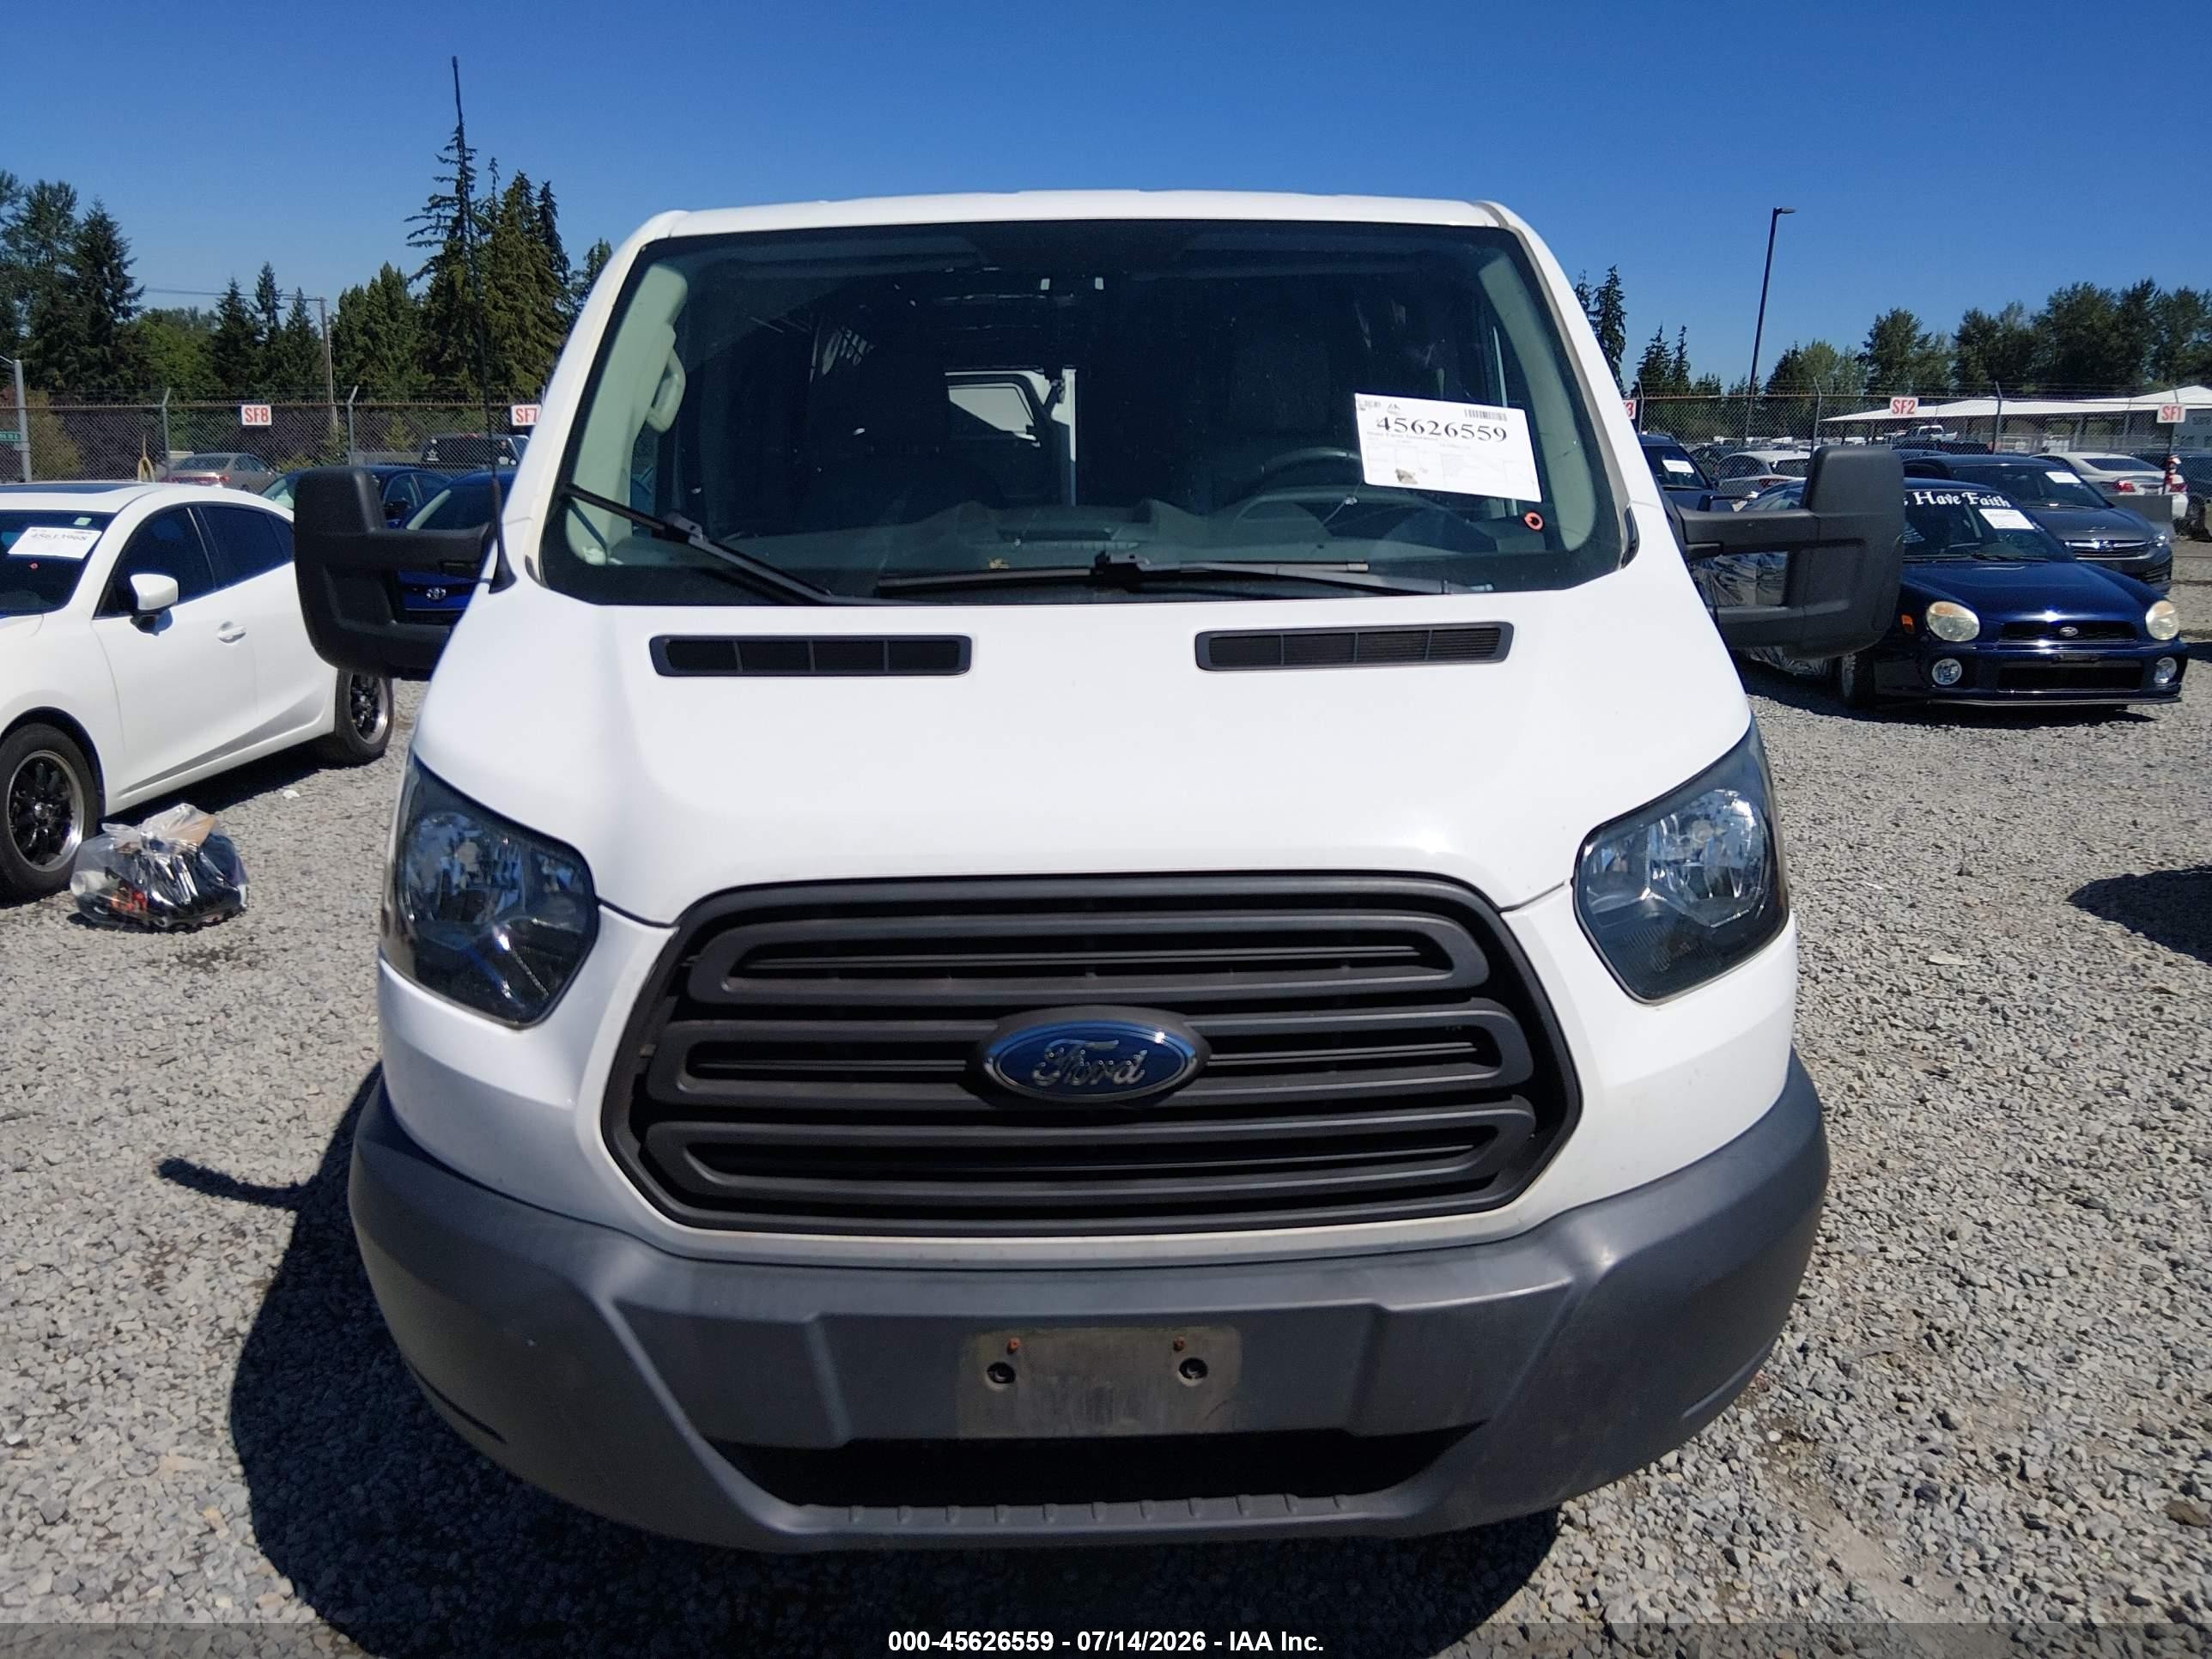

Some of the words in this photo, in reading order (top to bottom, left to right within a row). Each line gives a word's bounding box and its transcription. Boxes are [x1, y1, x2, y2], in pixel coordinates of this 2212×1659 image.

[245, 407, 269, 422] SF8
[1893, 399, 1916, 414] SF2
[2161, 405, 2183, 421] SF1
[516, 408, 537, 422] SF7
[1376, 416, 1508, 442] 45626559
[1912, 490, 1961, 506] Have
[1961, 492, 2012, 508] Faith
[1031, 1038, 1148, 1086] Ford
